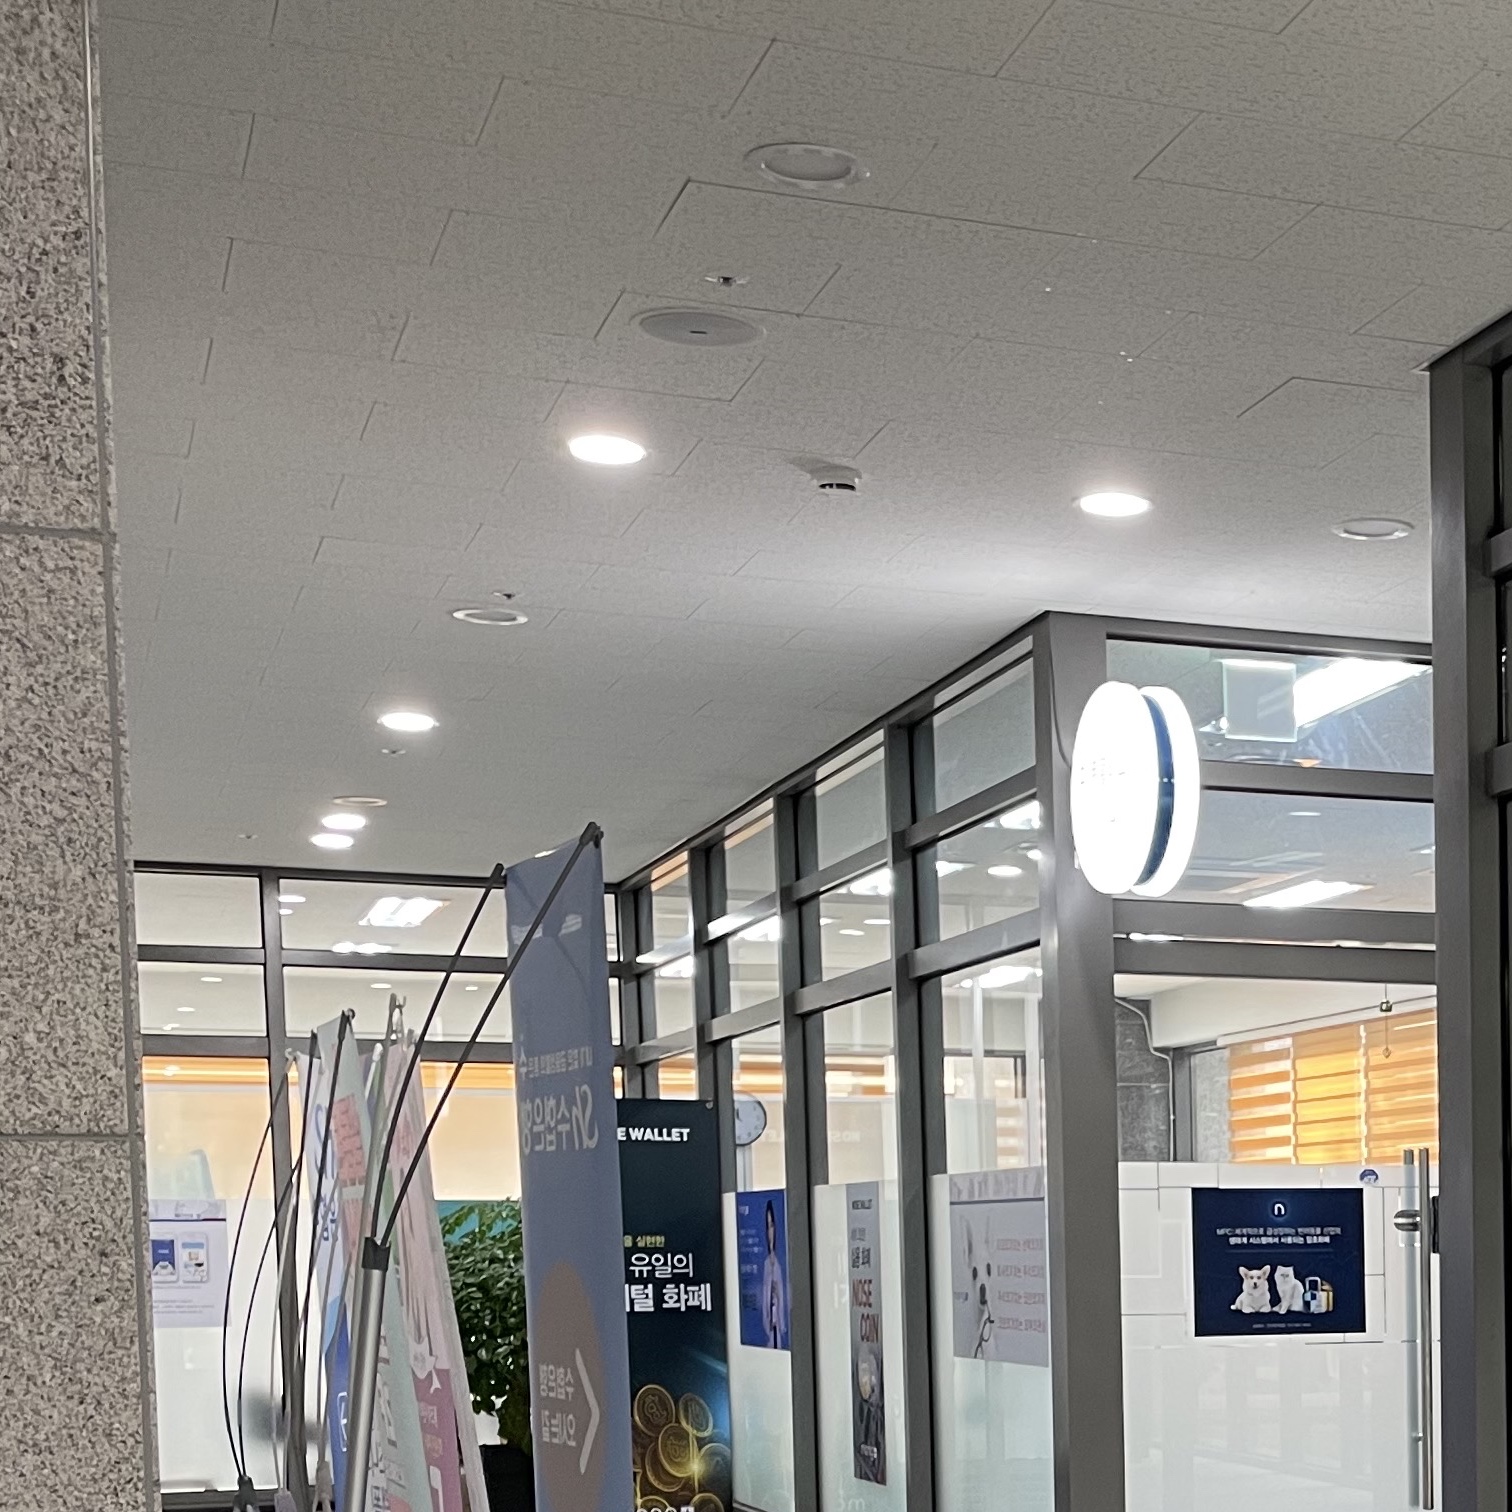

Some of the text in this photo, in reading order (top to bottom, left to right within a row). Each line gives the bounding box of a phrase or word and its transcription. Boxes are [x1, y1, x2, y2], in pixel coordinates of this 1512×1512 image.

[629, 1127, 690, 1142] WALLET
[629, 1252, 693, 1279] 유일의
[625, 1283, 655, 1312] 털
[662, 1283, 713, 1312] 화폐
